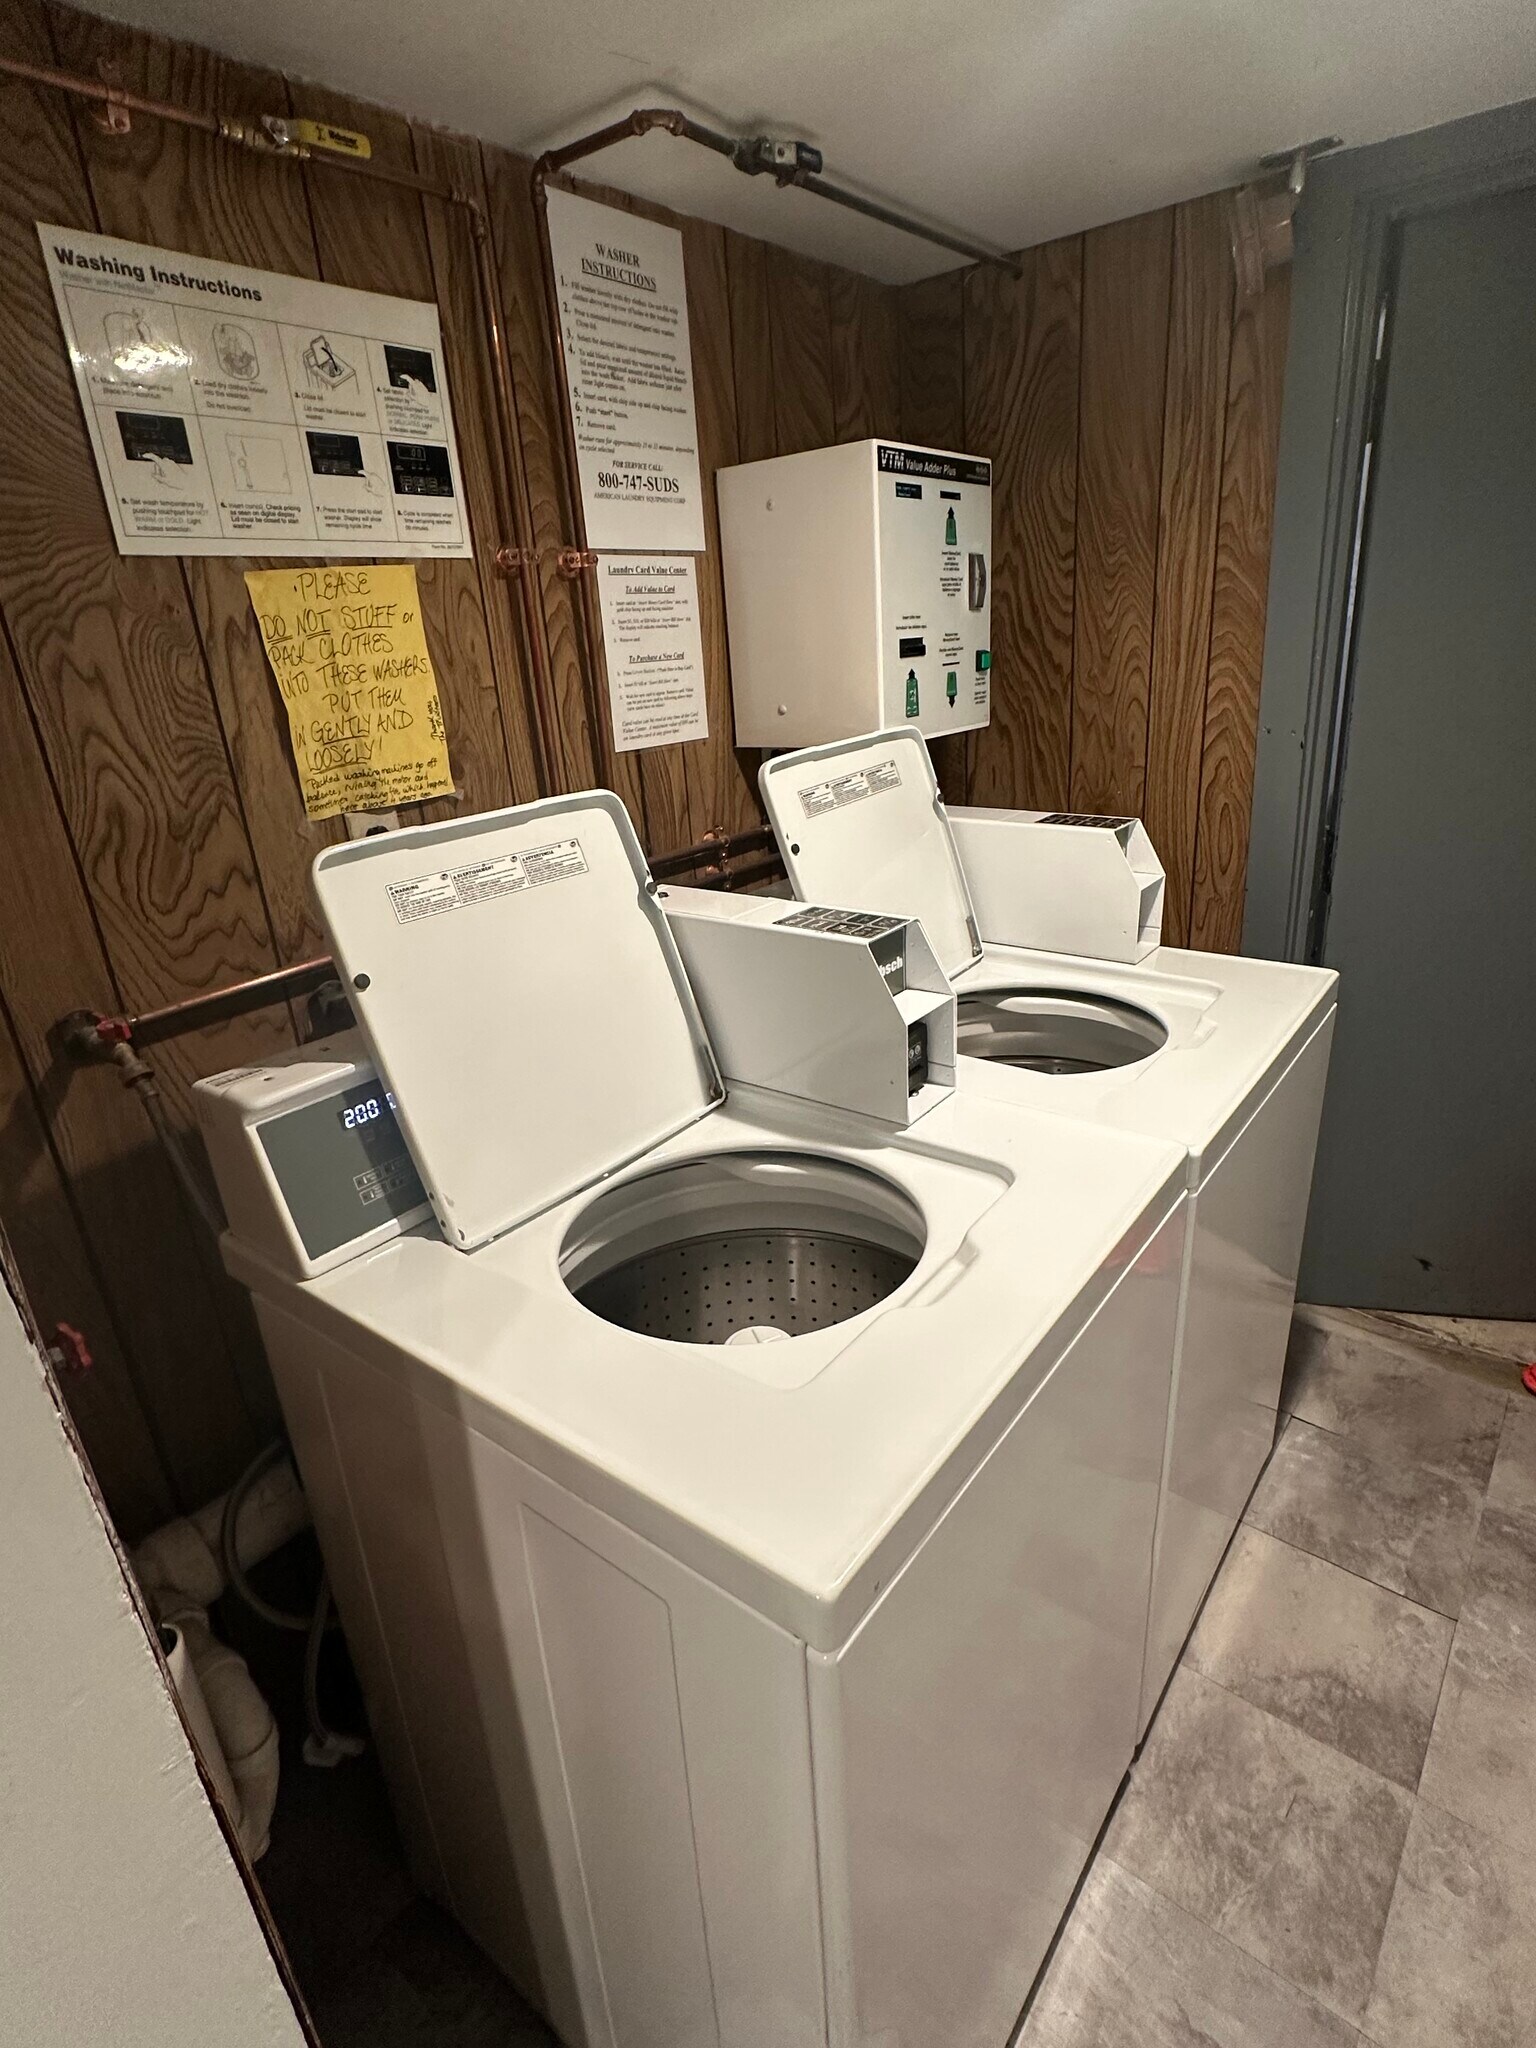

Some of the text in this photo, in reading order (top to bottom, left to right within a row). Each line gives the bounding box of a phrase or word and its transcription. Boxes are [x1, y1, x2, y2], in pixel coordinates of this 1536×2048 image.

[595, 244, 640, 267] WASHER
[53, 245, 146, 282] Washing
[148, 264, 262, 302] Instructions
[560, 274, 567, 287] 1.
[581, 258, 656, 288] INSTRUCTIONS
[562, 301, 570, 313] 2.
[566, 328, 573, 340] 3.
[567, 342, 575, 354] 4.
[572, 386, 581, 398] 5.
[574, 401, 582, 412] 6.
[576, 415, 583, 426] 7.
[624, 461, 647, 470] SERVICE
[881, 449, 905, 470] VTM
[906, 459, 923, 472] Value
[924, 461, 942, 474] Adder
[943, 464, 957, 476] Plus
[597, 471, 679, 493] 800-747-SUDS
[593, 491, 620, 500] AMERICAN
[621, 493, 644, 501] LAUNDRY
[607, 565, 633, 573] Laundry
[297, 572, 370, 601] PLEASE
[260, 615, 286, 639] DO
[297, 609, 331, 635] NOT
[341, 604, 397, 629] STUFF
[269, 633, 393, 669] PACK CLOTHES
[636, 653, 657, 661] Purchase
[316, 662, 369, 688] THESE
[323, 687, 404, 713] PUT THEM
[311, 715, 371, 742] GENTLY
[377, 710, 413, 732] AND
[306, 737, 382, 771] LOOSELY!
[414, 760, 424, 773] go
[426, 757, 438, 768] off
[394, 885, 419, 894] WARNING
